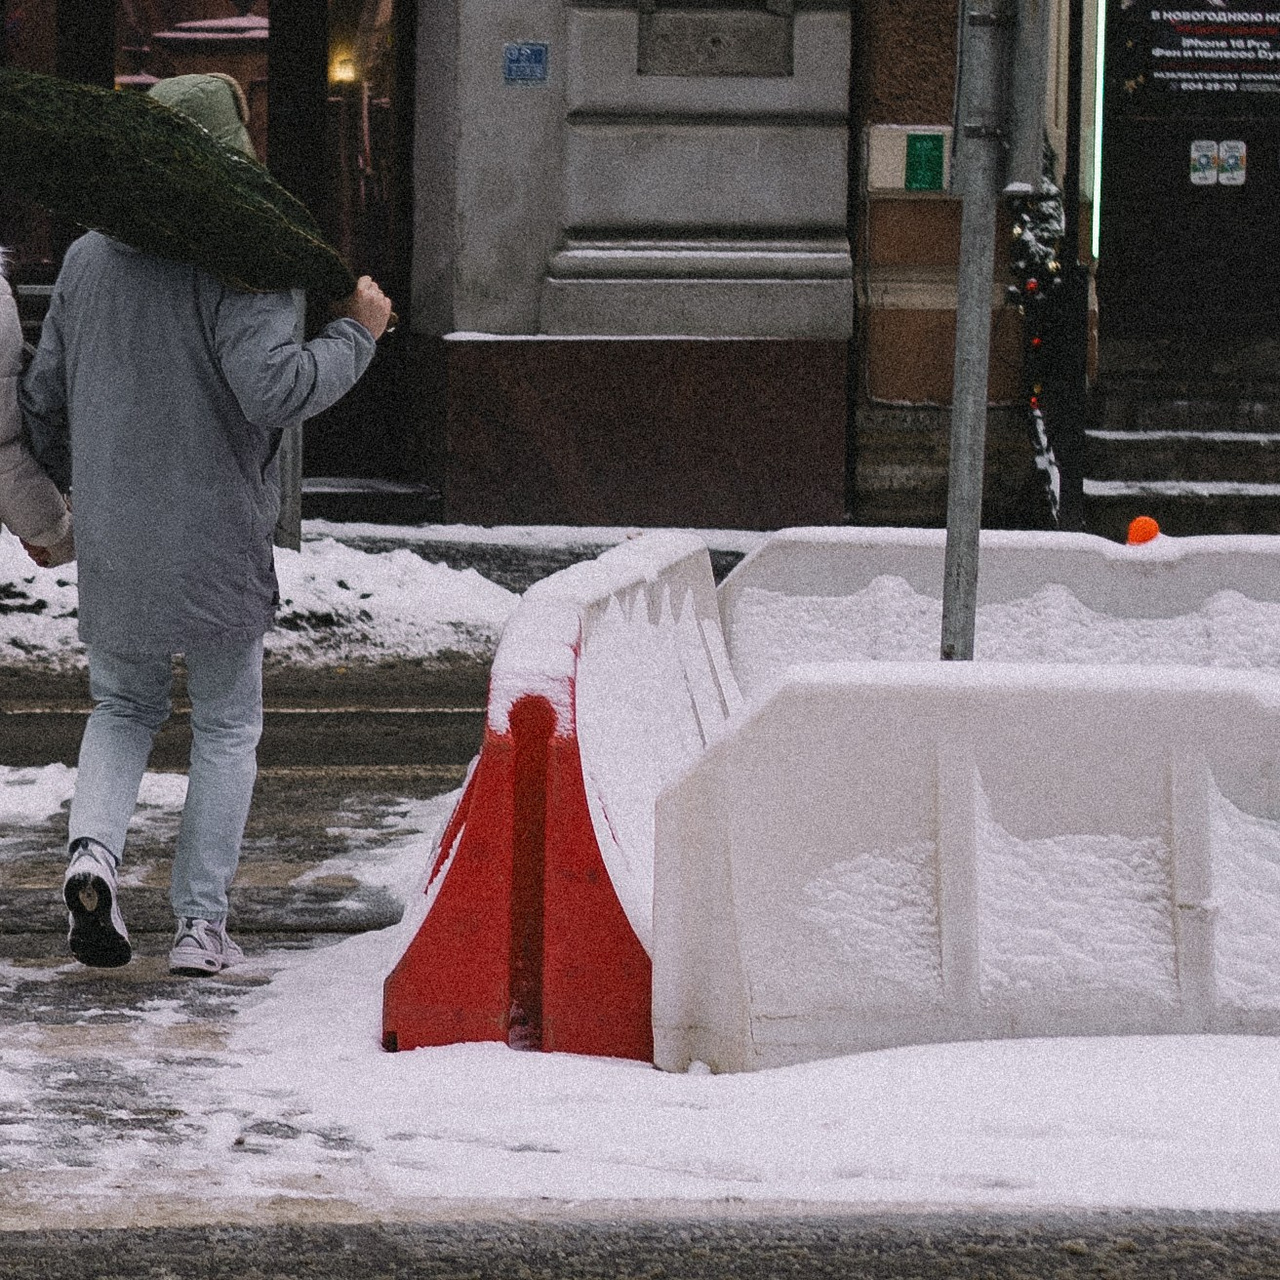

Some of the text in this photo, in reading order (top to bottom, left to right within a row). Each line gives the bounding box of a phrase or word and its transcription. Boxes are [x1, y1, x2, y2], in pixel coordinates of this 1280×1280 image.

[1151, 10, 1161, 21] В
[1163, 10, 1263, 23] НОВОГОДНЮЮ
[1181, 36, 1228, 49] iPhone
[1247, 39, 1271, 50] Pro
[1151, 47, 1180, 58] Фен
[1182, 49, 1193, 58] и
[1194, 50, 1256, 59] пылесос
